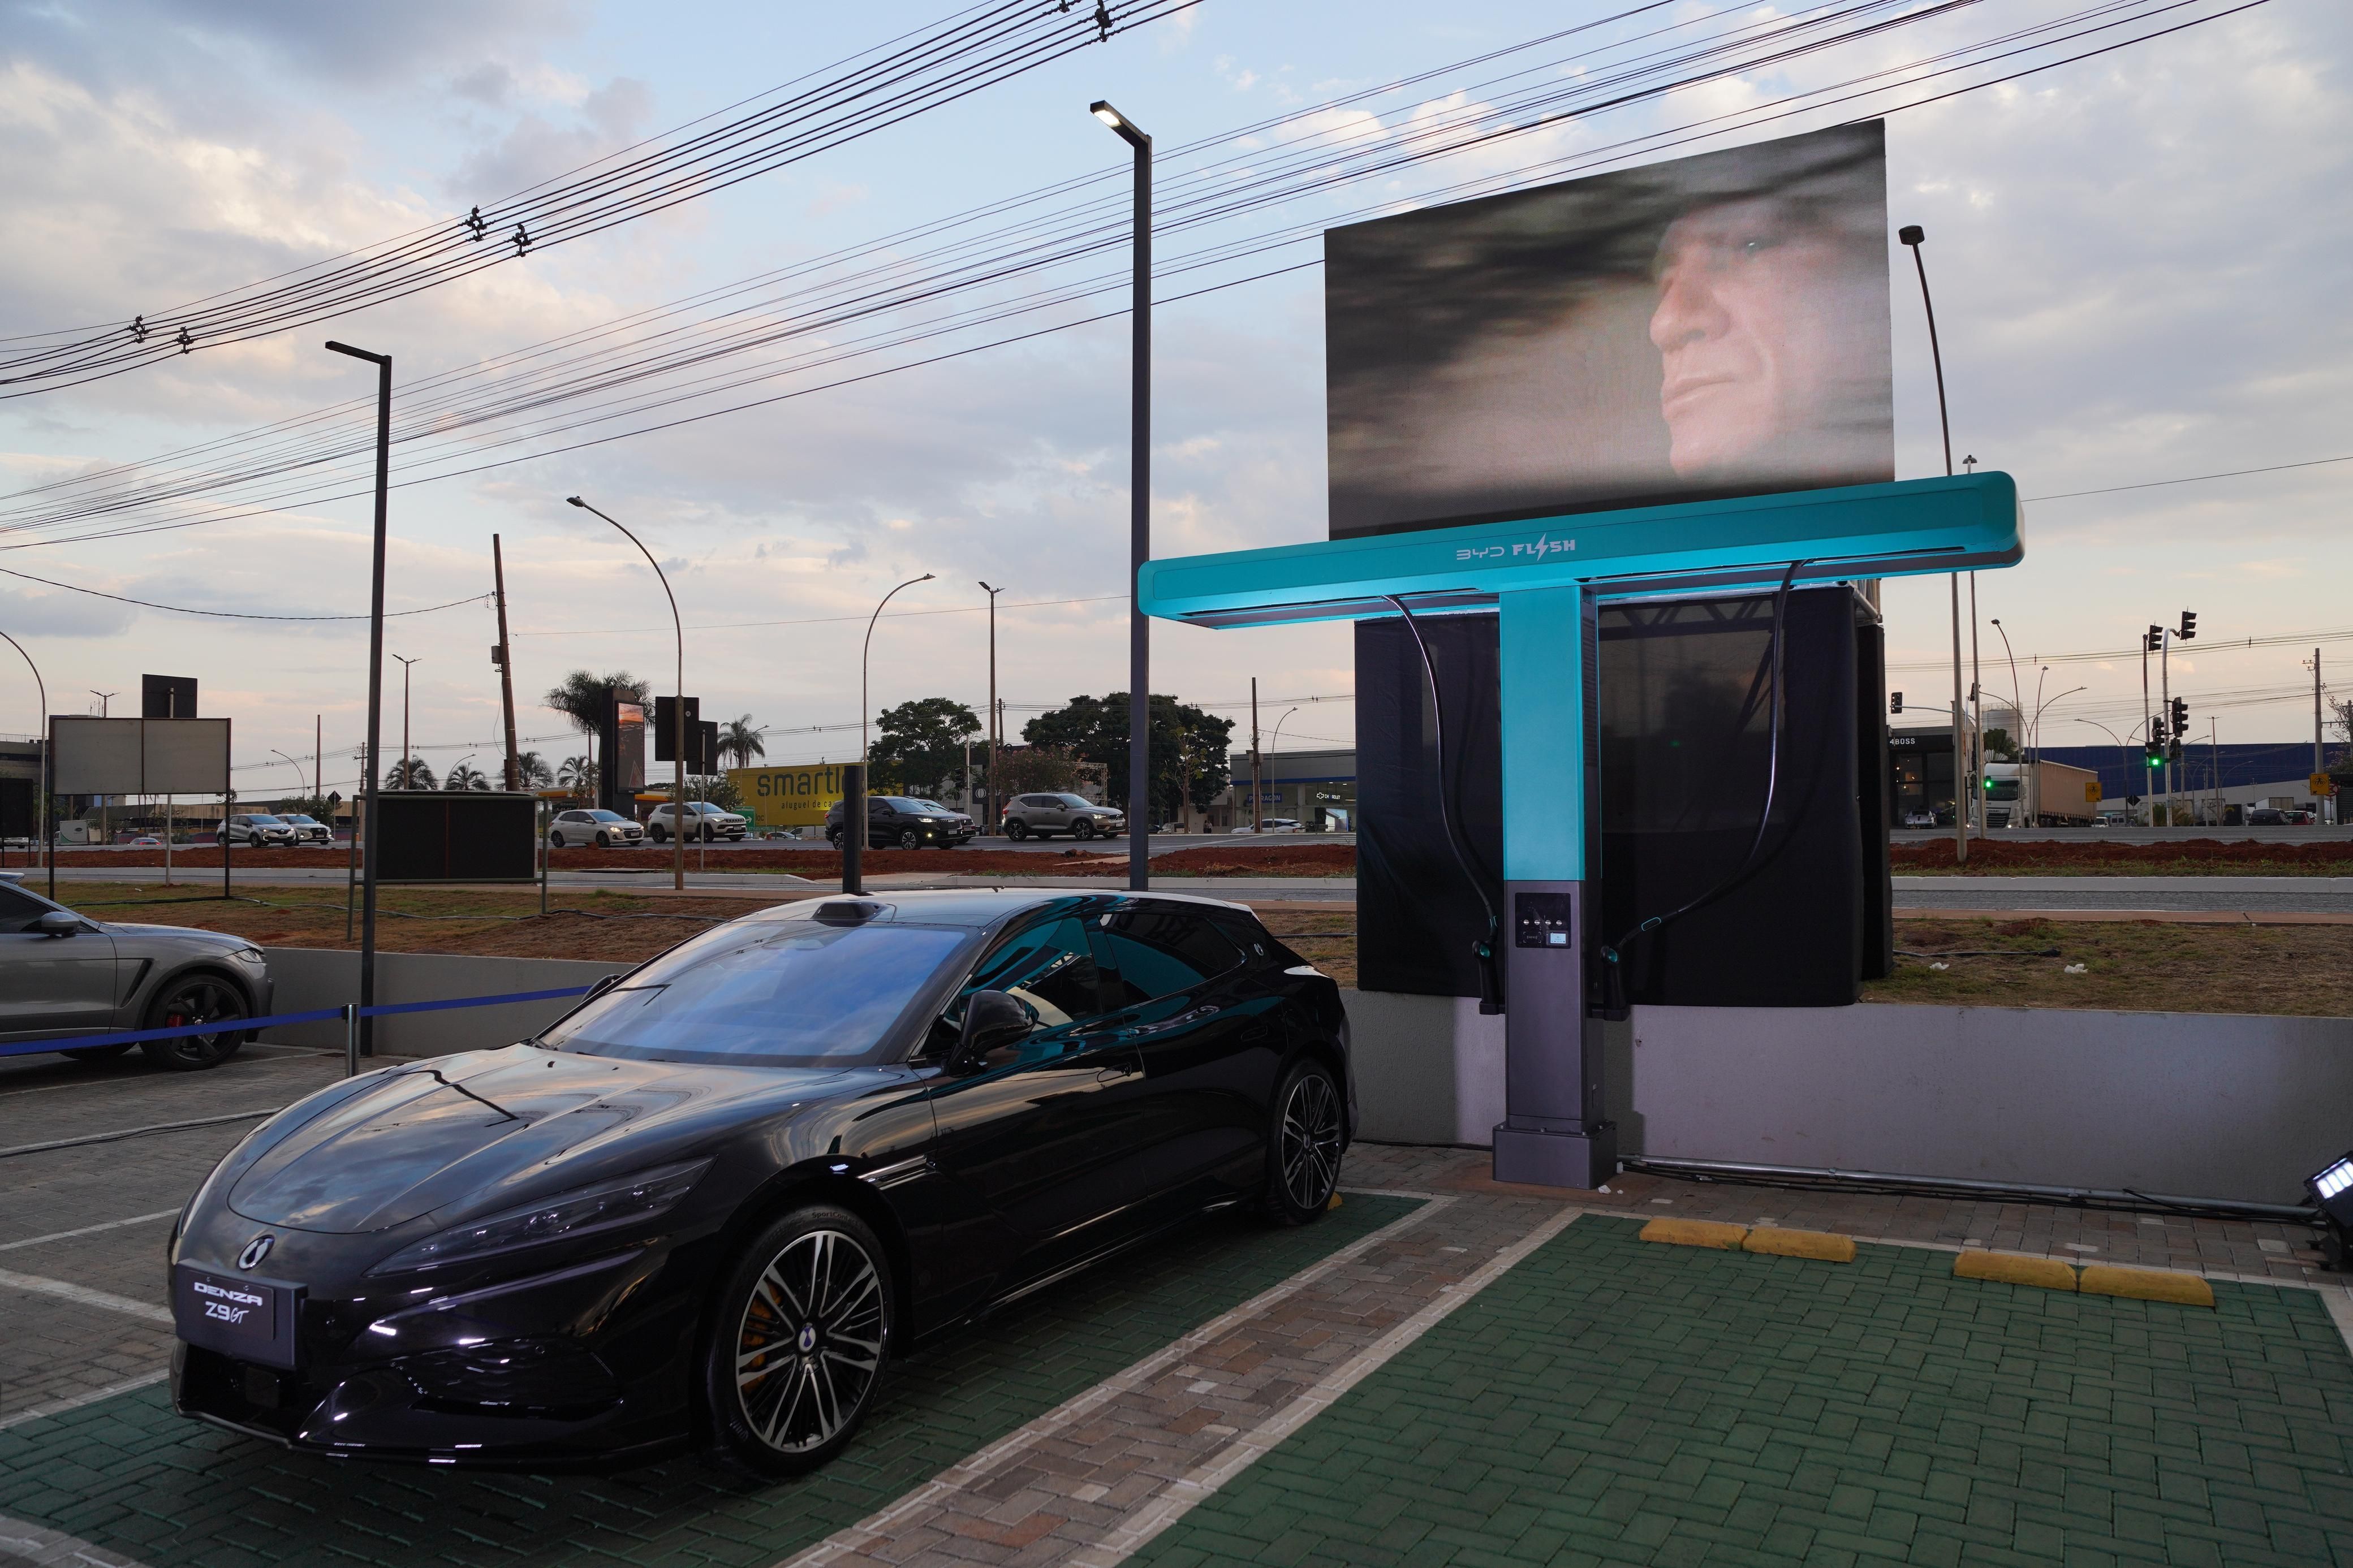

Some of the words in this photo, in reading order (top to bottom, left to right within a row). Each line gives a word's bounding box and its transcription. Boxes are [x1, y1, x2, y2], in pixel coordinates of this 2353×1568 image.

[1456, 546, 1505, 560] BYD
[757, 766, 844, 797] smartl
[781, 801, 809, 810] aluguel
[194, 1282, 262, 1307] DENZA
[205, 1301, 249, 1324] Z9GT
